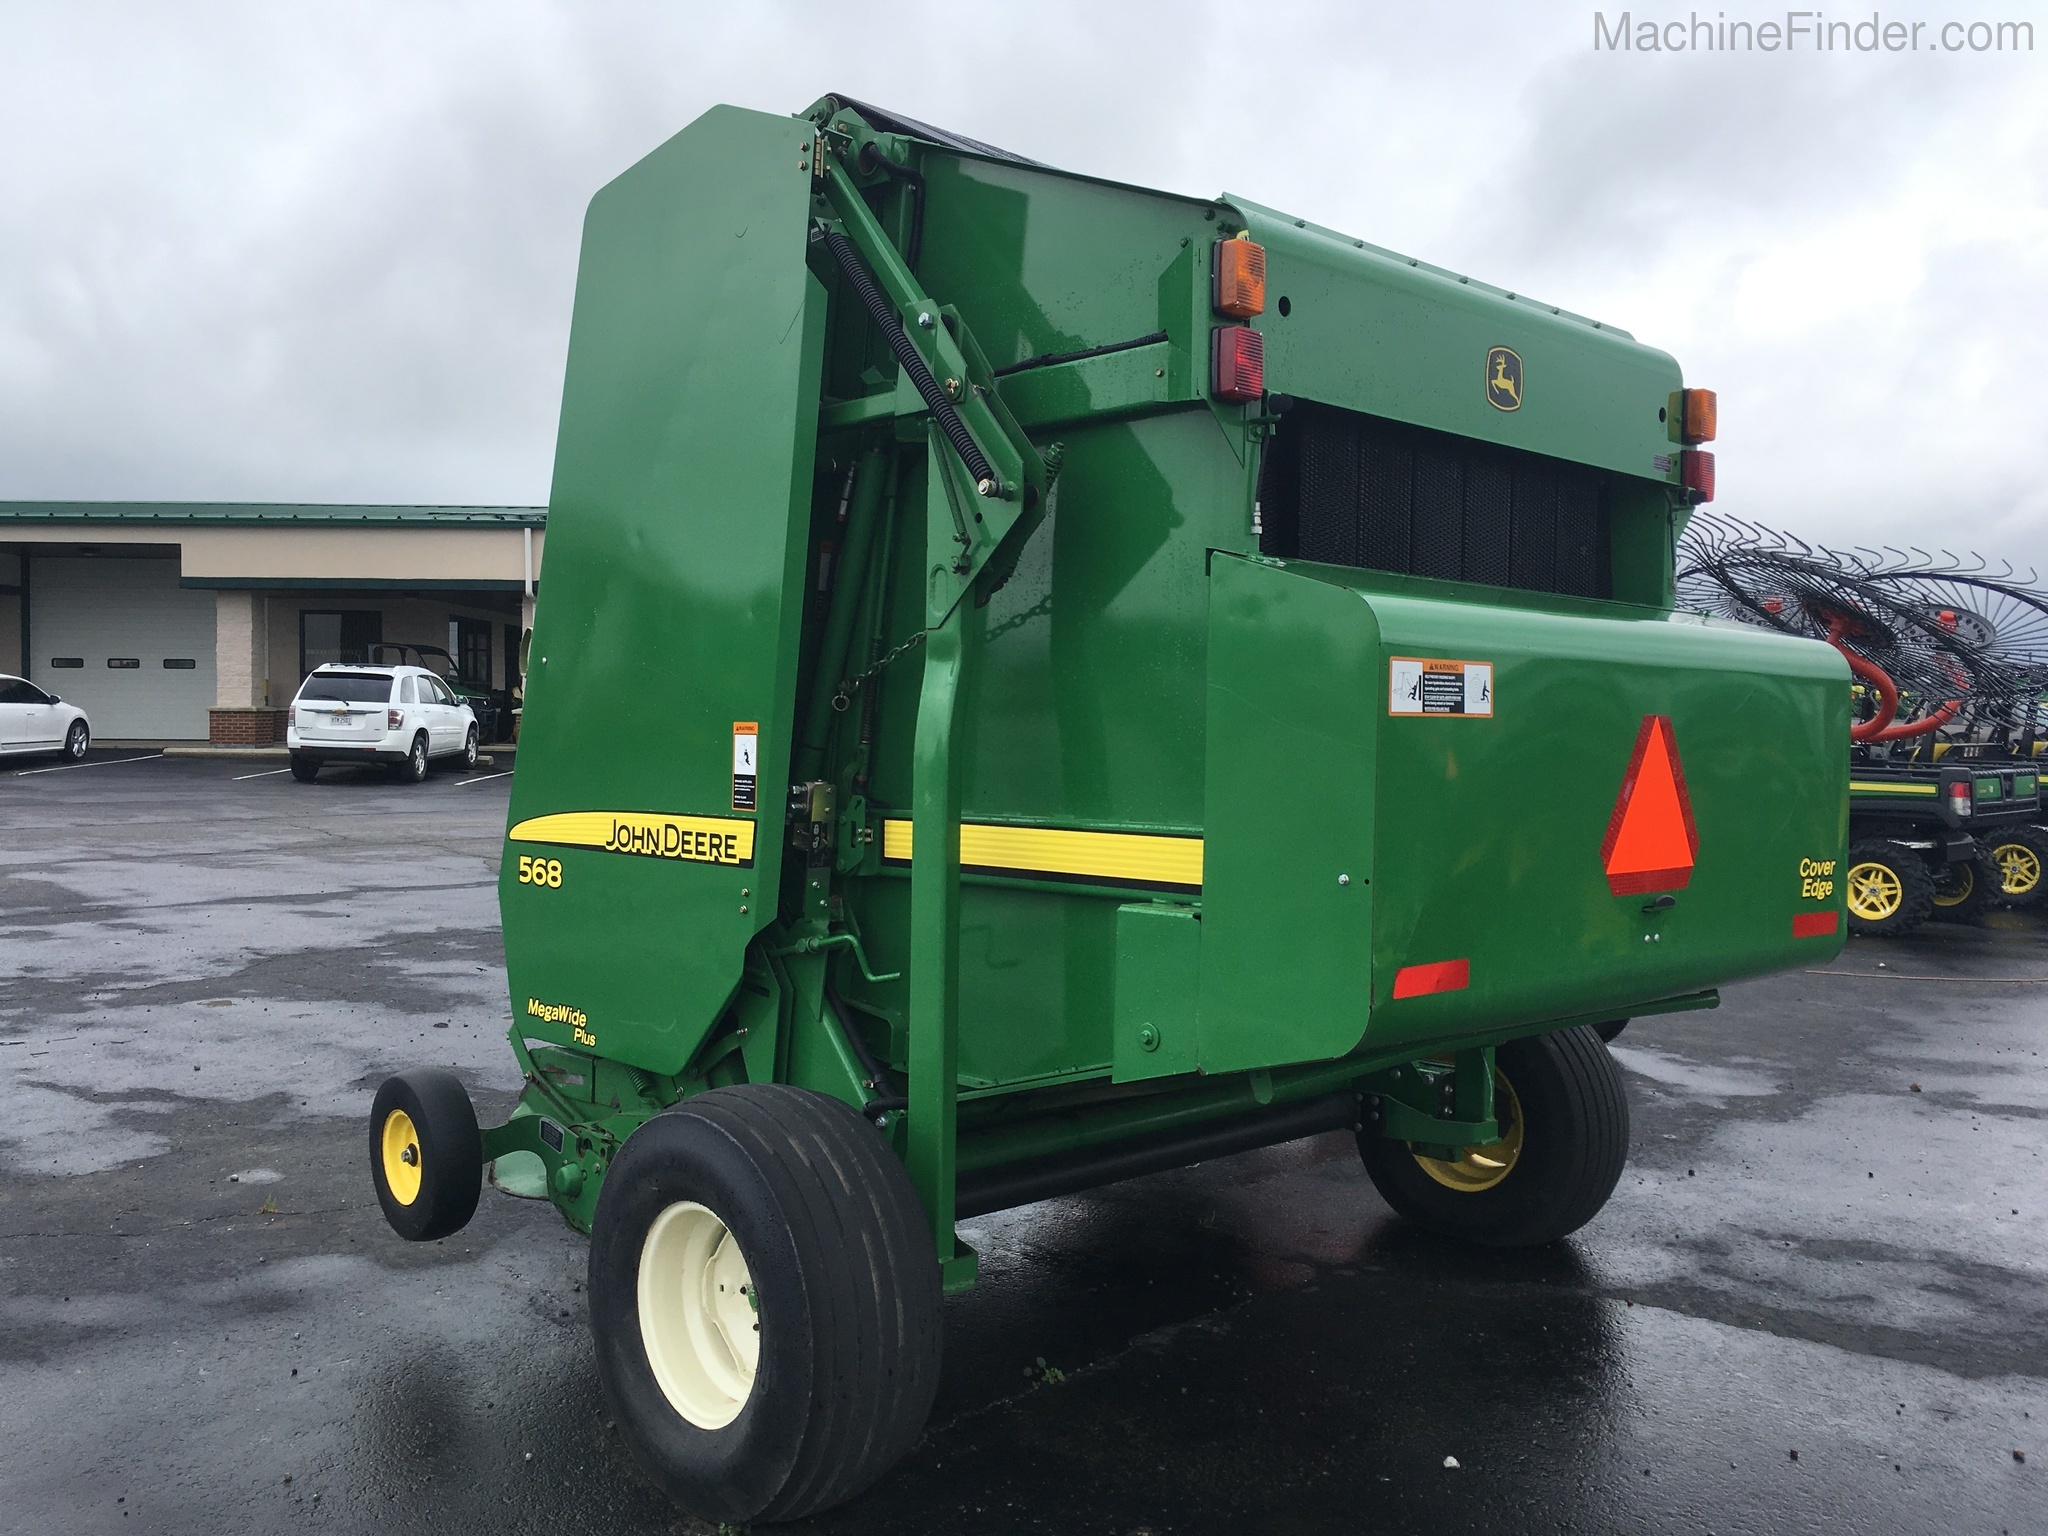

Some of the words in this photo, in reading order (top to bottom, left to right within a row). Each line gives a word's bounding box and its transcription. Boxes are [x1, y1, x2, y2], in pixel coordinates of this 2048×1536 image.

[1434, 662, 1459, 672] WARNING
[518, 855, 563, 889] 568
[1799, 857, 1836, 878] Cover
[1802, 878, 1834, 900] Edge
[527, 997, 587, 1028] MegaWide
[573, 1027, 596, 1047] Plus
